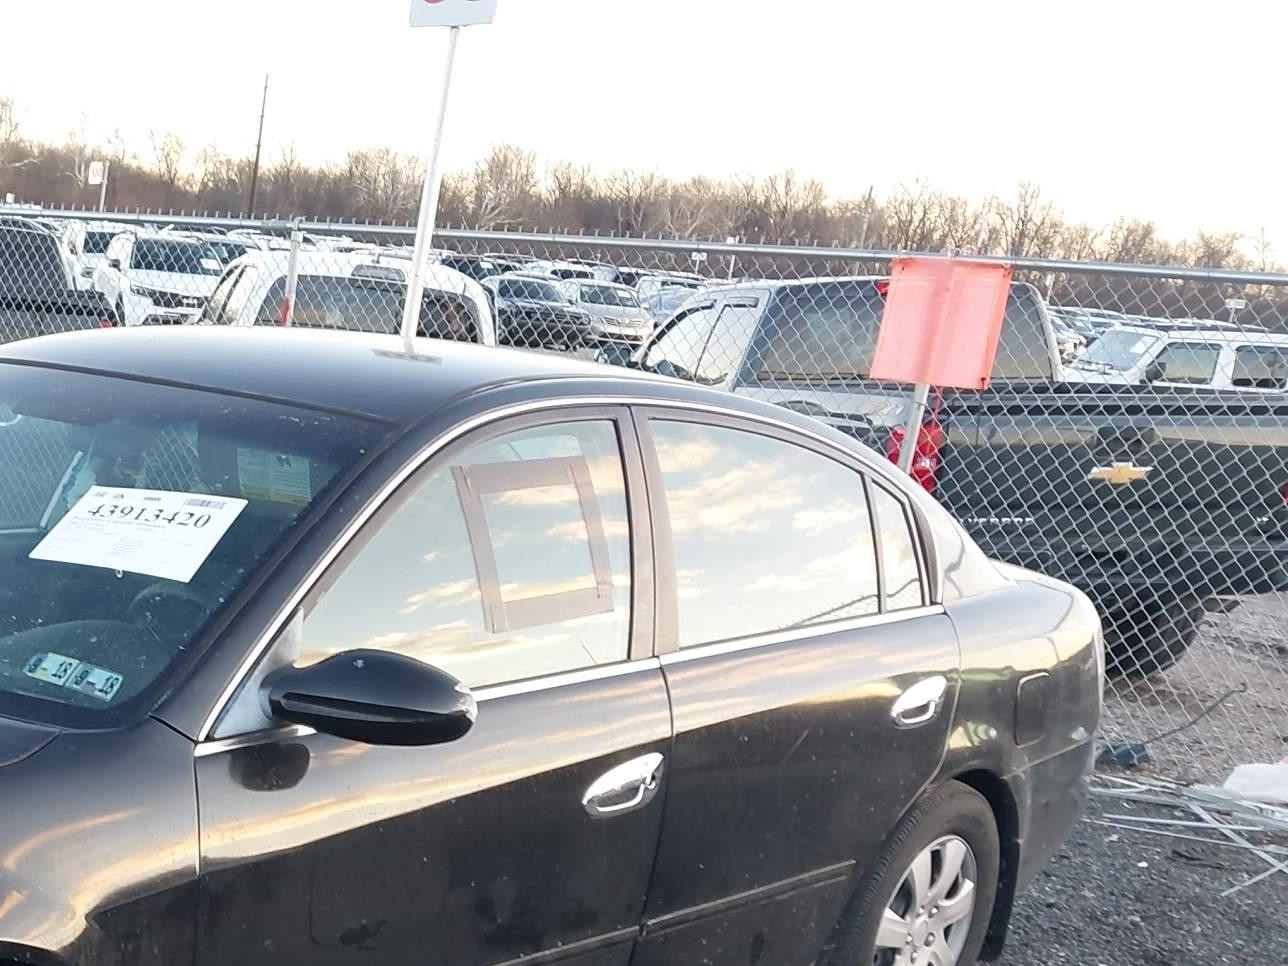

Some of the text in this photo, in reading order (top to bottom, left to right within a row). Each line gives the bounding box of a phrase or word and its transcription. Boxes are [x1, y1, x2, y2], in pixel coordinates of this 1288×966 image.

[87, 503, 212, 529] 43913420
[51, 661, 73, 679] 18
[98, 675, 120, 695] 18
